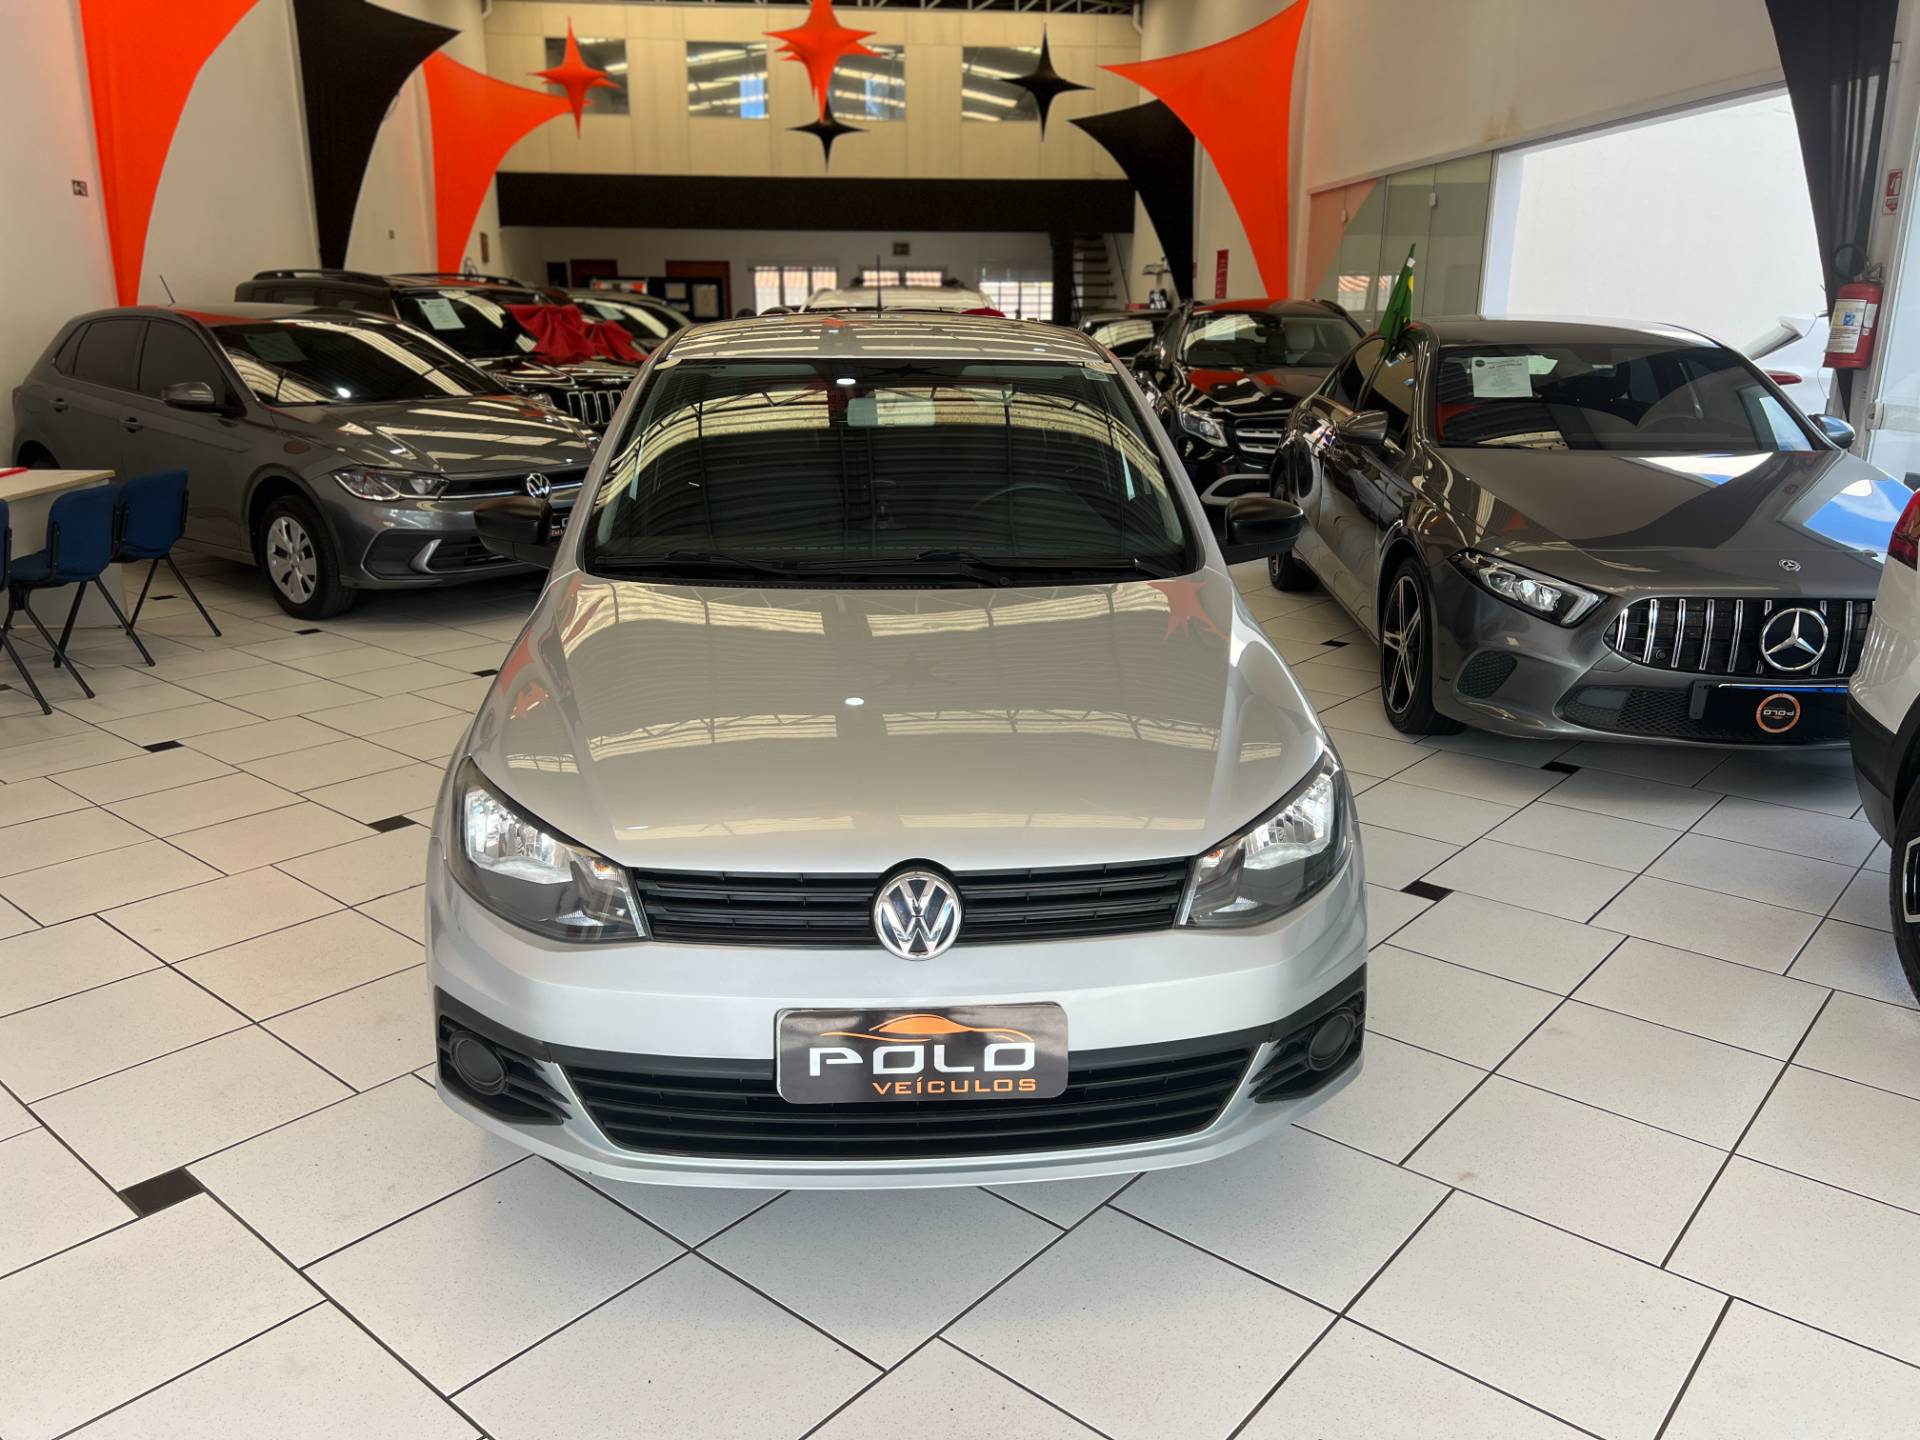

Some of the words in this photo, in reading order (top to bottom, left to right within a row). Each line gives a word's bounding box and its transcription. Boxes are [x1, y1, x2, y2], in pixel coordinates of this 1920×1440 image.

[876, 872, 959, 958] VW
[809, 1042, 1035, 1076] POLO
[872, 1077, 1037, 1095] VEÍCULOS
